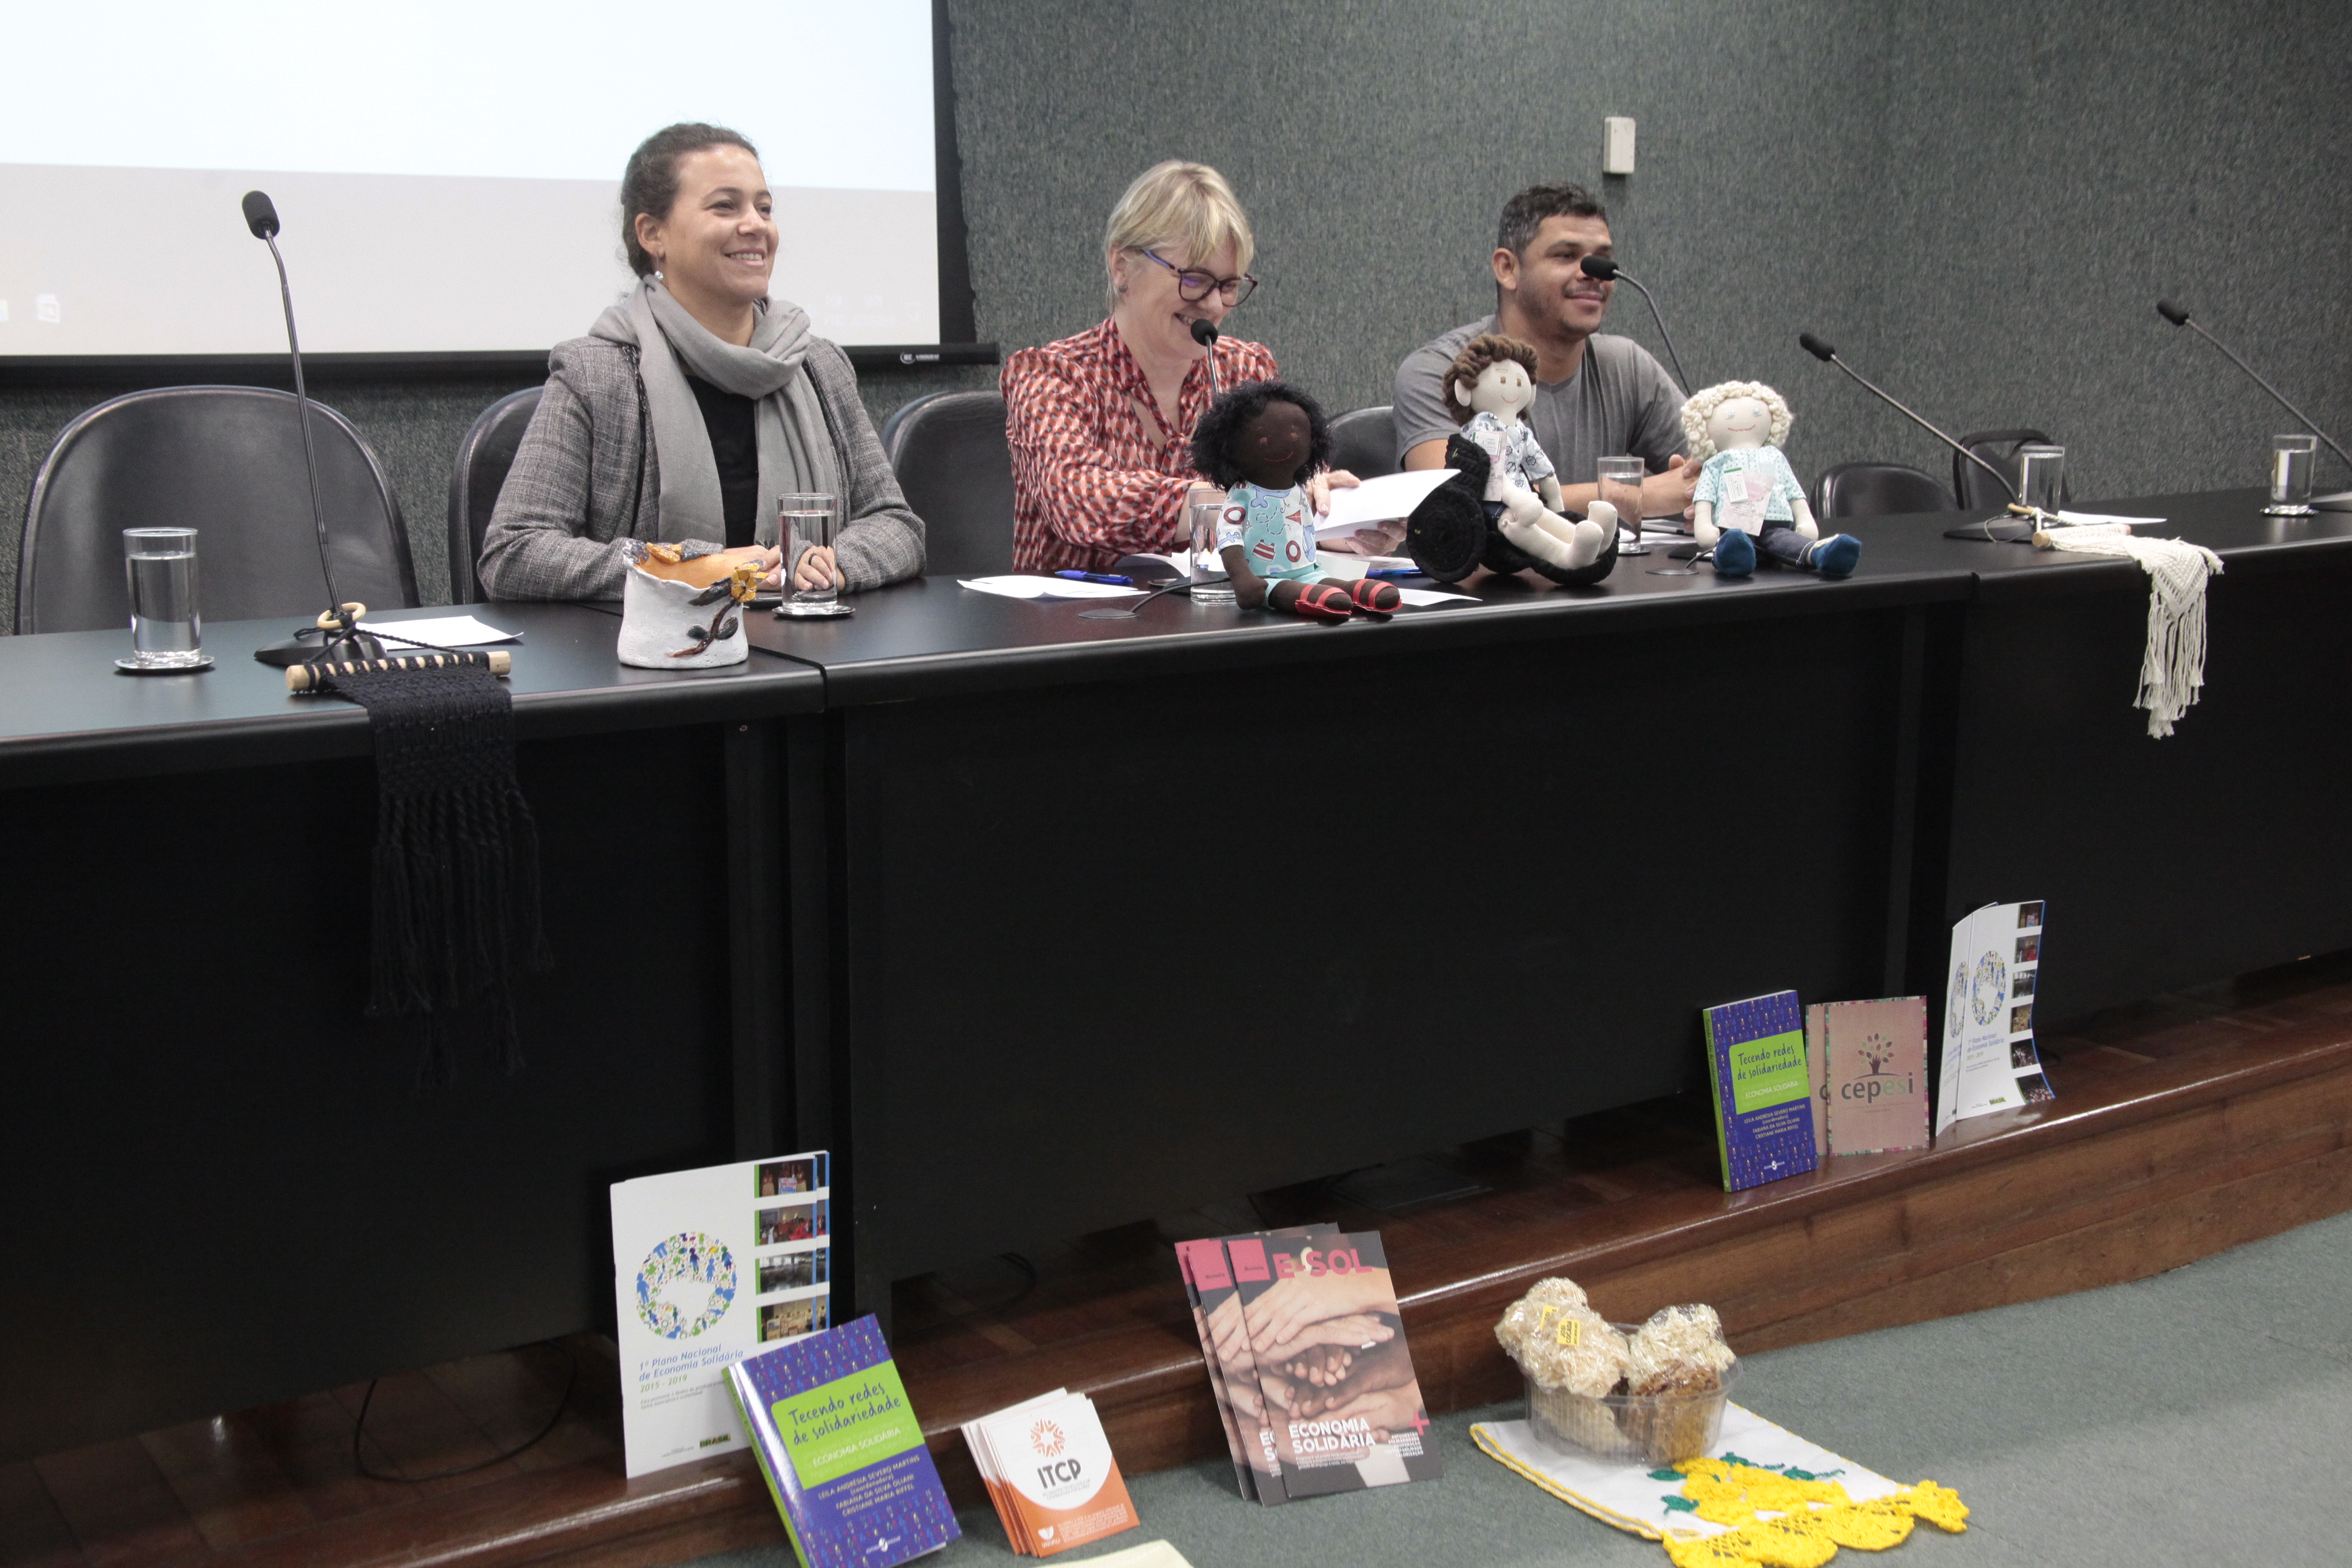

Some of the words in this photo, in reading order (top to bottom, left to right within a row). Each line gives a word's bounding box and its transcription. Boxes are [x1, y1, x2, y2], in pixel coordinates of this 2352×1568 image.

[1738, 1048, 1770, 1065] Tecendo
[1773, 1043, 1794, 1057] redes
[1737, 1068, 1746, 1080] de
[1749, 1056, 1801, 1079] solidariedade
[1745, 1087, 1773, 1099] ECONOMIA
[1841, 1072, 1913, 1103] cepesi
[1753, 1125, 1769, 1133] FABIANA
[1755, 1130, 1774, 1139] CRISTIANE
[1272, 1248, 1373, 1279] E-SOL
[639, 1371, 650, 1382] de
[654, 1360, 698, 1378] Economia
[702, 1350, 744, 1366] Solidária
[652, 1356, 678, 1368] Plano
[681, 1343, 722, 1360] Nacional
[640, 1381, 659, 1393] 2015
[668, 1374, 688, 1386] 2019
[789, 1396, 845, 1426] Tecendo
[850, 1382, 885, 1405] redes
[793, 1429, 809, 1446] de
[812, 1395, 901, 1440] solidariedade
[1288, 1417, 1370, 1439] ECONOMIA
[812, 1443, 858, 1468] ECONOMIA
[868, 1465, 892, 1480] SEVERO
[893, 1454, 920, 1471] MARTINS
[1036, 1458, 1081, 1489] ITCP
[836, 1494, 864, 1510] FABIANA
[864, 1490, 874, 1499] DA
[875, 1483, 892, 1495] SILVA
[842, 1499, 873, 1517] CRISTIANE
[875, 1491, 895, 1504] MARIA
